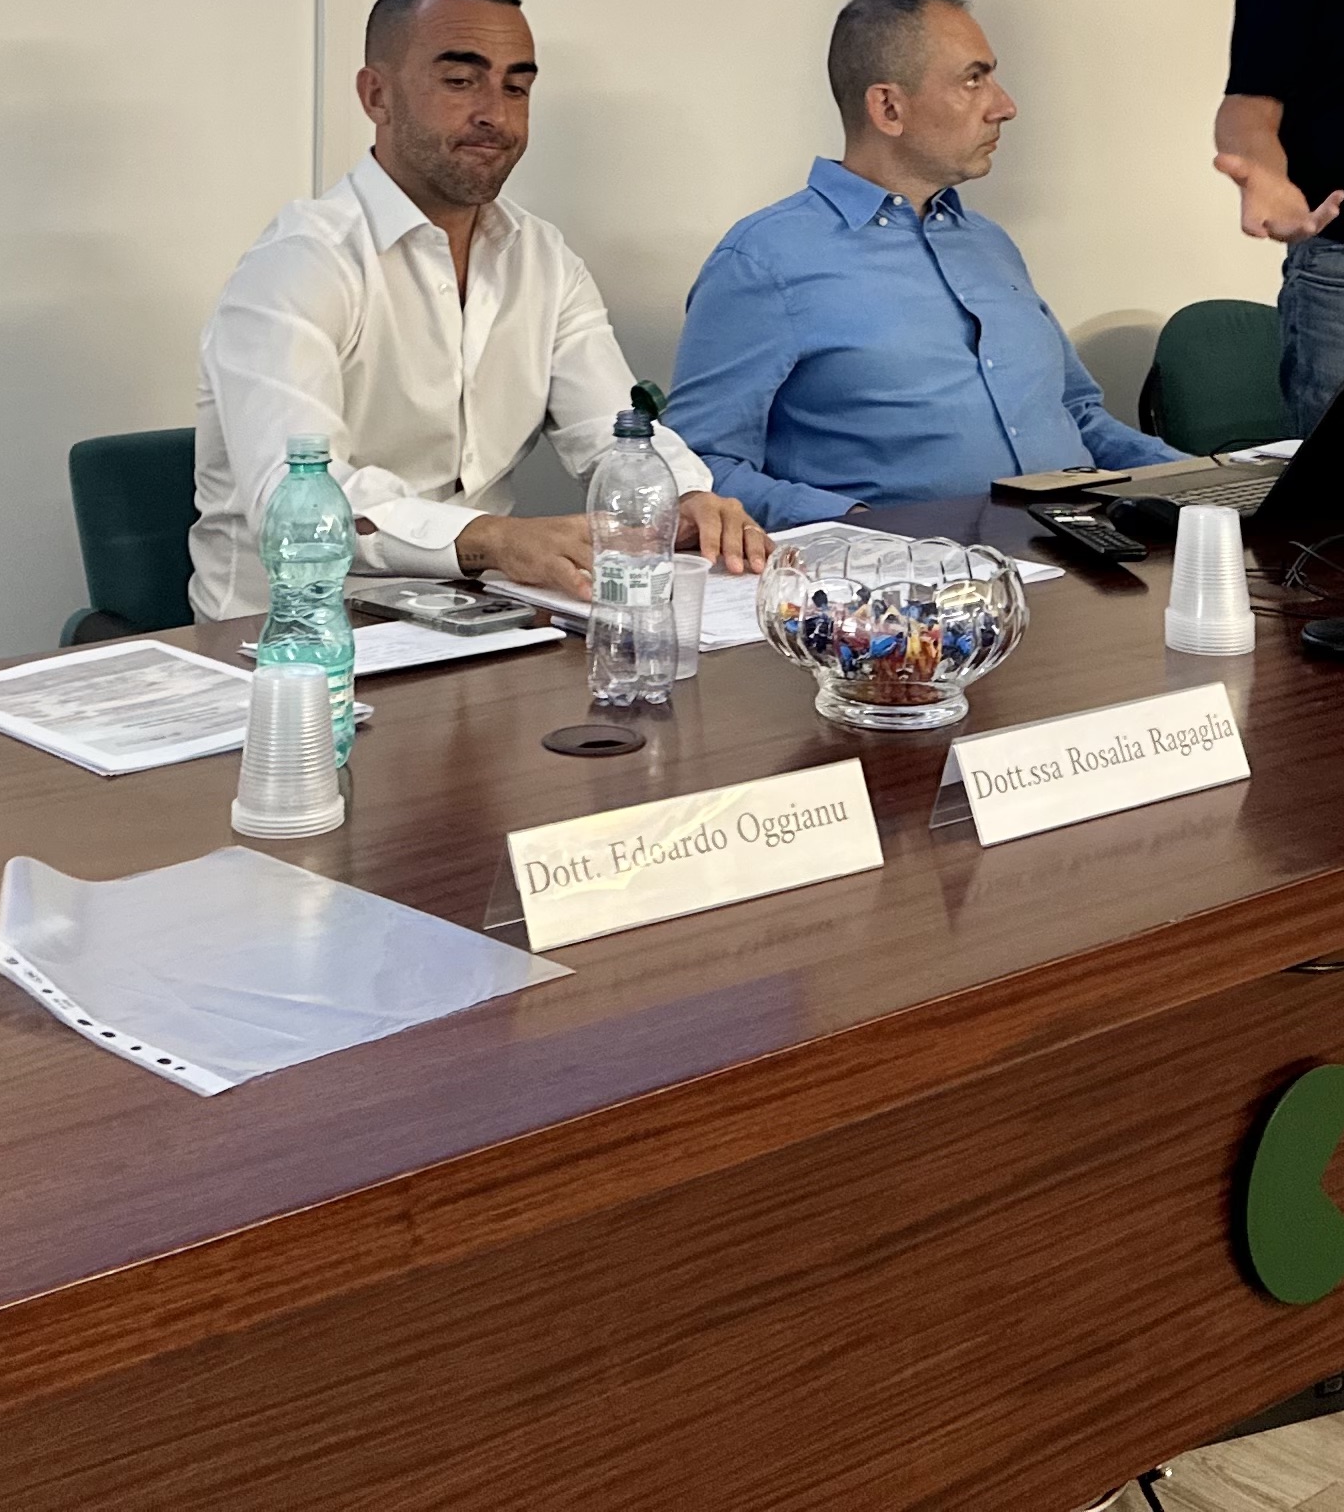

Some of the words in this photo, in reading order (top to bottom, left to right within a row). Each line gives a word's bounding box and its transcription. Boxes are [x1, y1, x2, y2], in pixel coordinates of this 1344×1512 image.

[971, 760, 1064, 800] Dott.ssa
[1067, 735, 1146, 776] Rosalia
[1147, 713, 1235, 757] Ragaglia
[525, 854, 602, 896] Dott.
[608, 823, 728, 875] Edoardo
[736, 799, 849, 849] Oggianu
